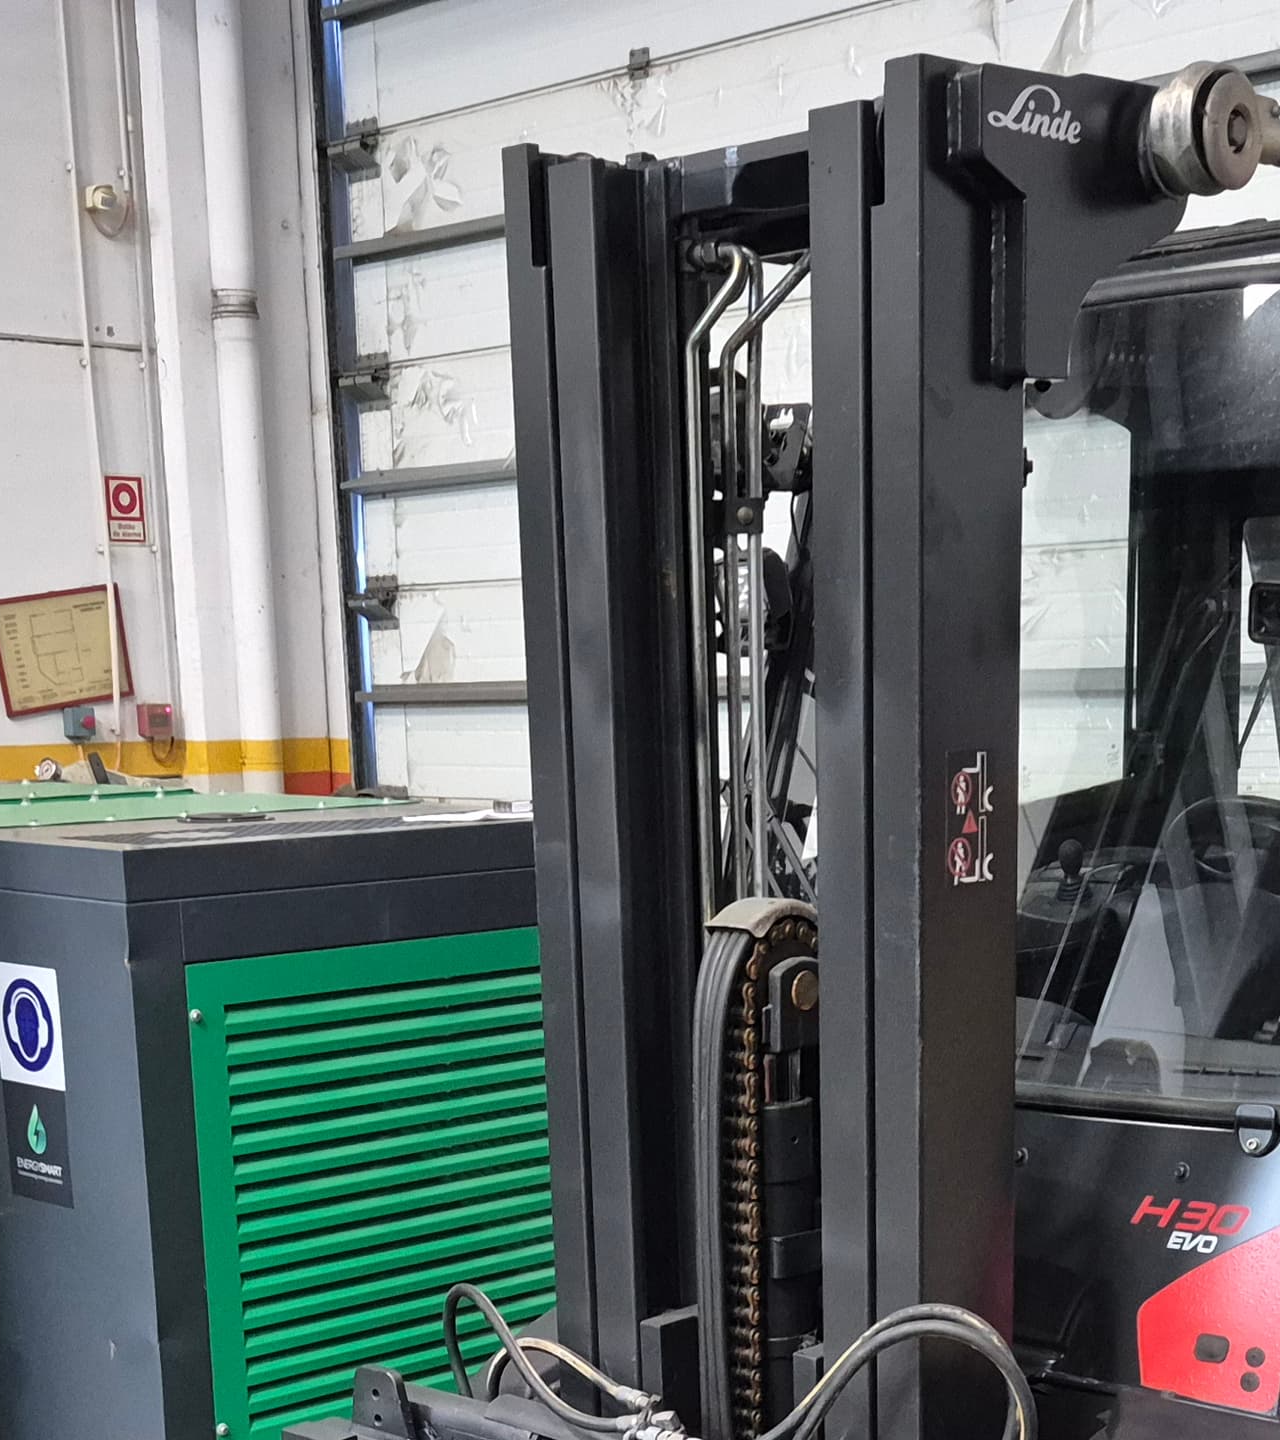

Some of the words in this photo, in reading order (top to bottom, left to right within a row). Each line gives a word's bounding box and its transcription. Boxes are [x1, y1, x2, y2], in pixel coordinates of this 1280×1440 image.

[987, 84, 1082, 144] Linde
[1129, 1194, 1252, 1236] H30
[1166, 1230, 1218, 1254] EVO
